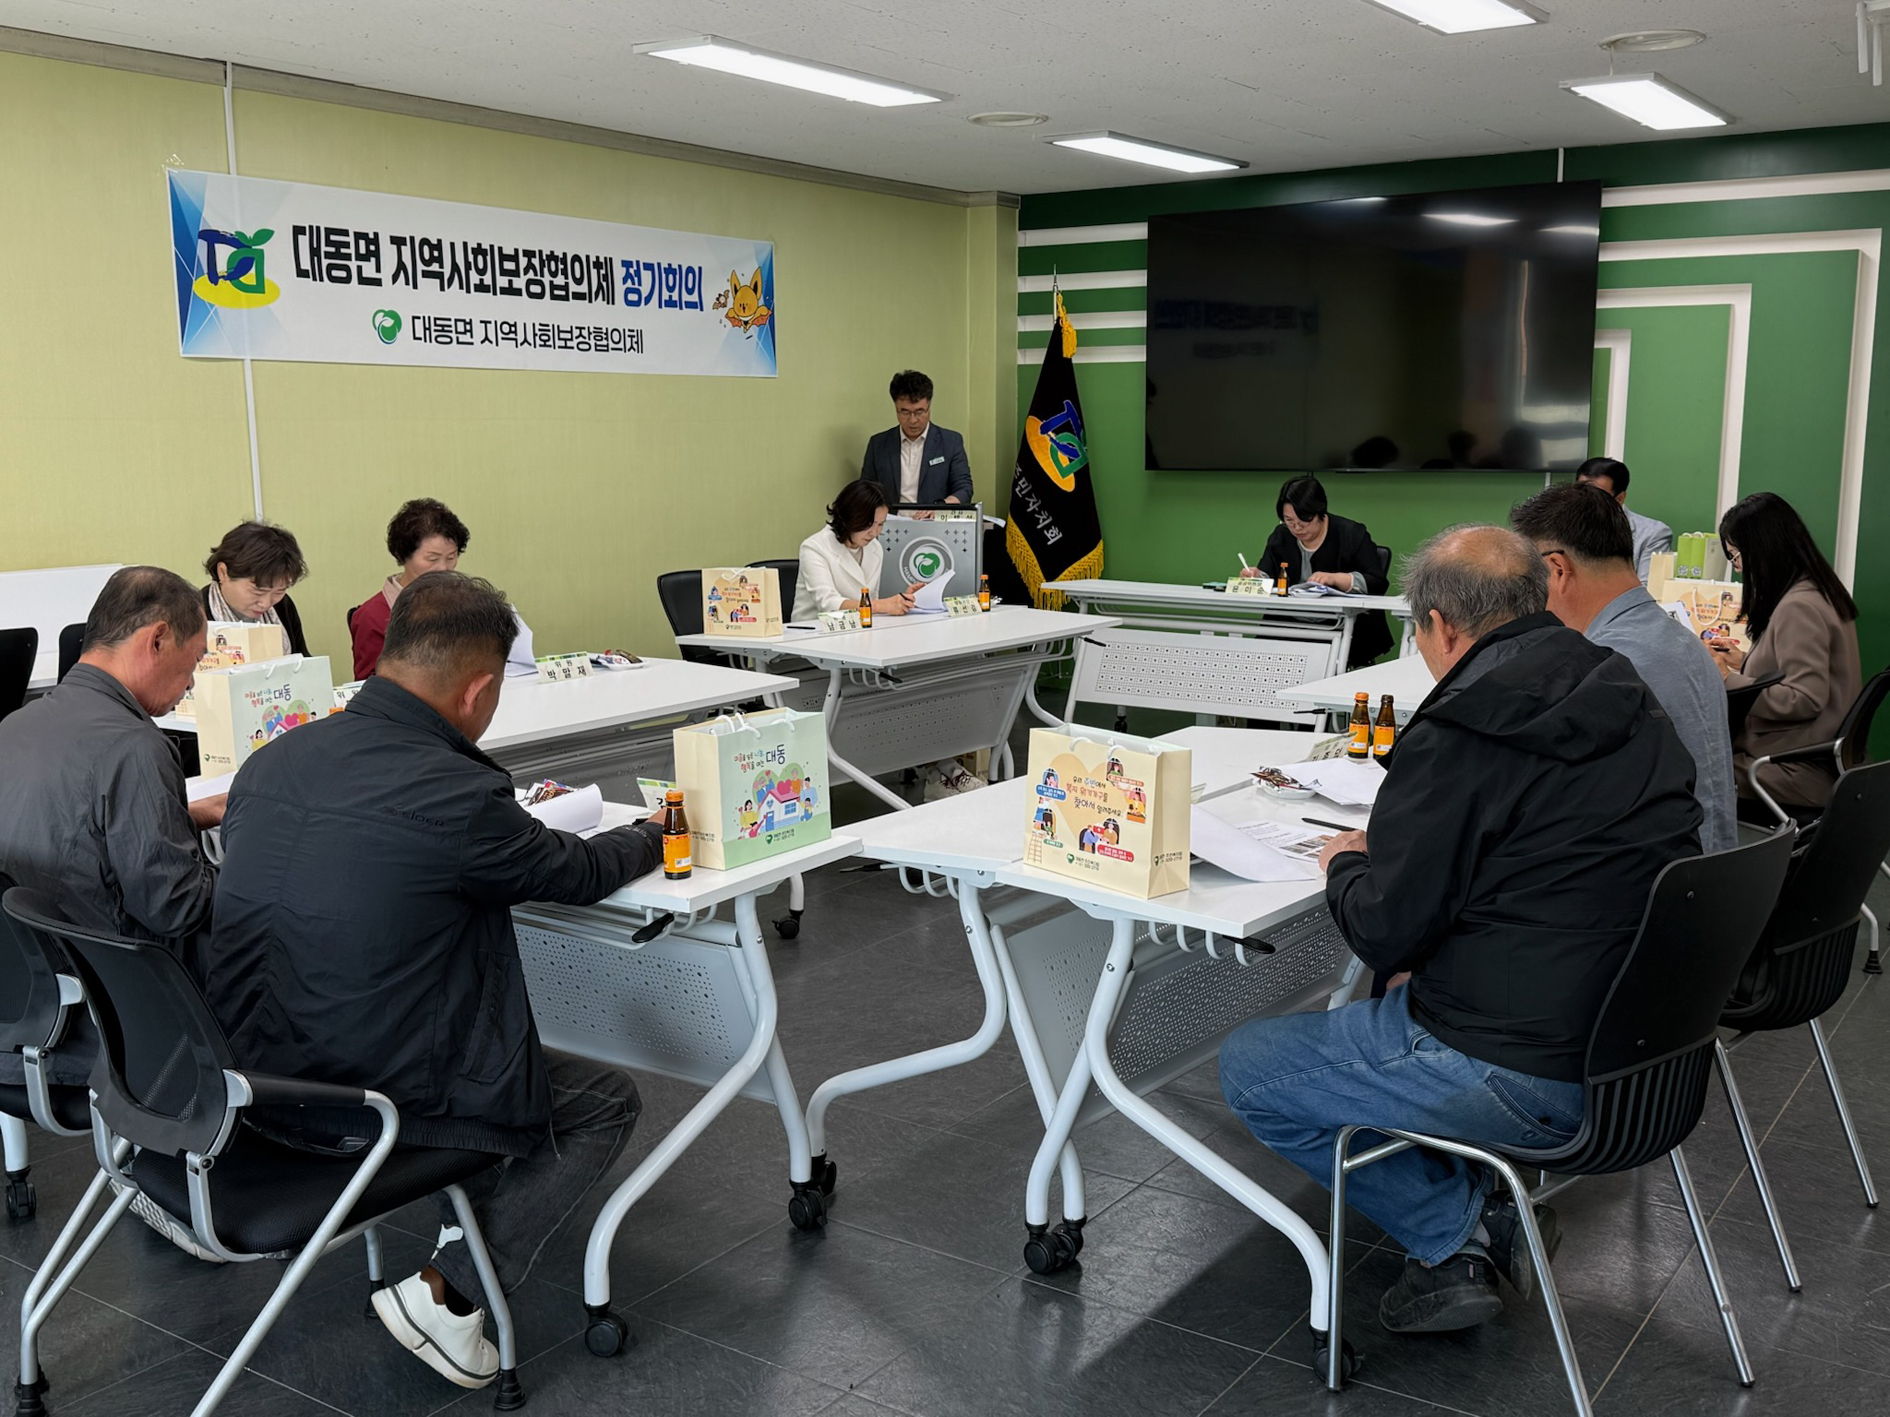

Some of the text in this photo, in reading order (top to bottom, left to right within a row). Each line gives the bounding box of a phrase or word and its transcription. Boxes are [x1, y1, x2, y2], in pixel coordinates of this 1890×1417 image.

[292, 224, 704, 312] 대동면 지역사회보장협의체 정기회의
[411, 315, 644, 354] 대동면 지역사회보장협의체
[273, 683, 292, 701] 대동
[765, 743, 786, 765] 대동
[1066, 782, 1078, 793] 복지
[1084, 777, 1107, 789] 주변에서
[1074, 796, 1096, 809] 찾아서
